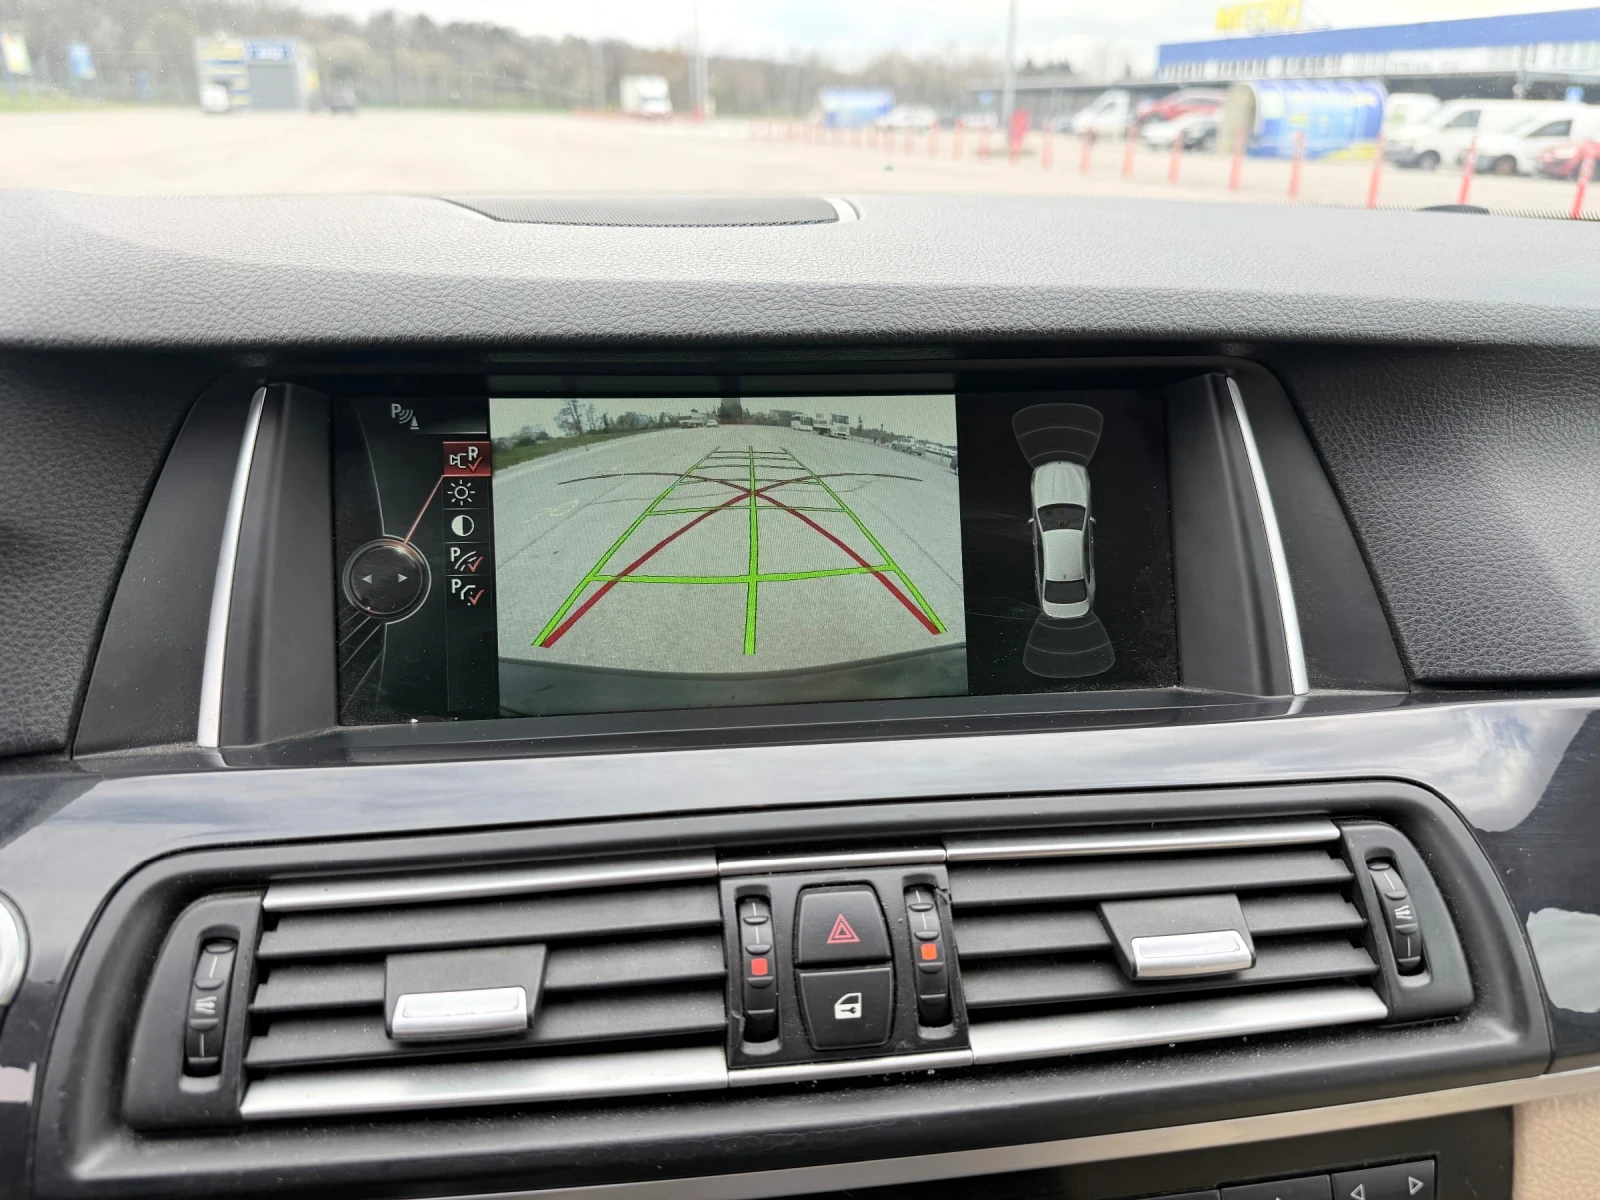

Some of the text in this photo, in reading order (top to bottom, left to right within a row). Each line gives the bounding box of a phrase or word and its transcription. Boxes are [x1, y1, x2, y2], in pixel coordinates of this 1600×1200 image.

[391, 403, 402, 419] P
[468, 446, 479, 461] R
[450, 546, 461, 562] P
[451, 578, 462, 594] P
